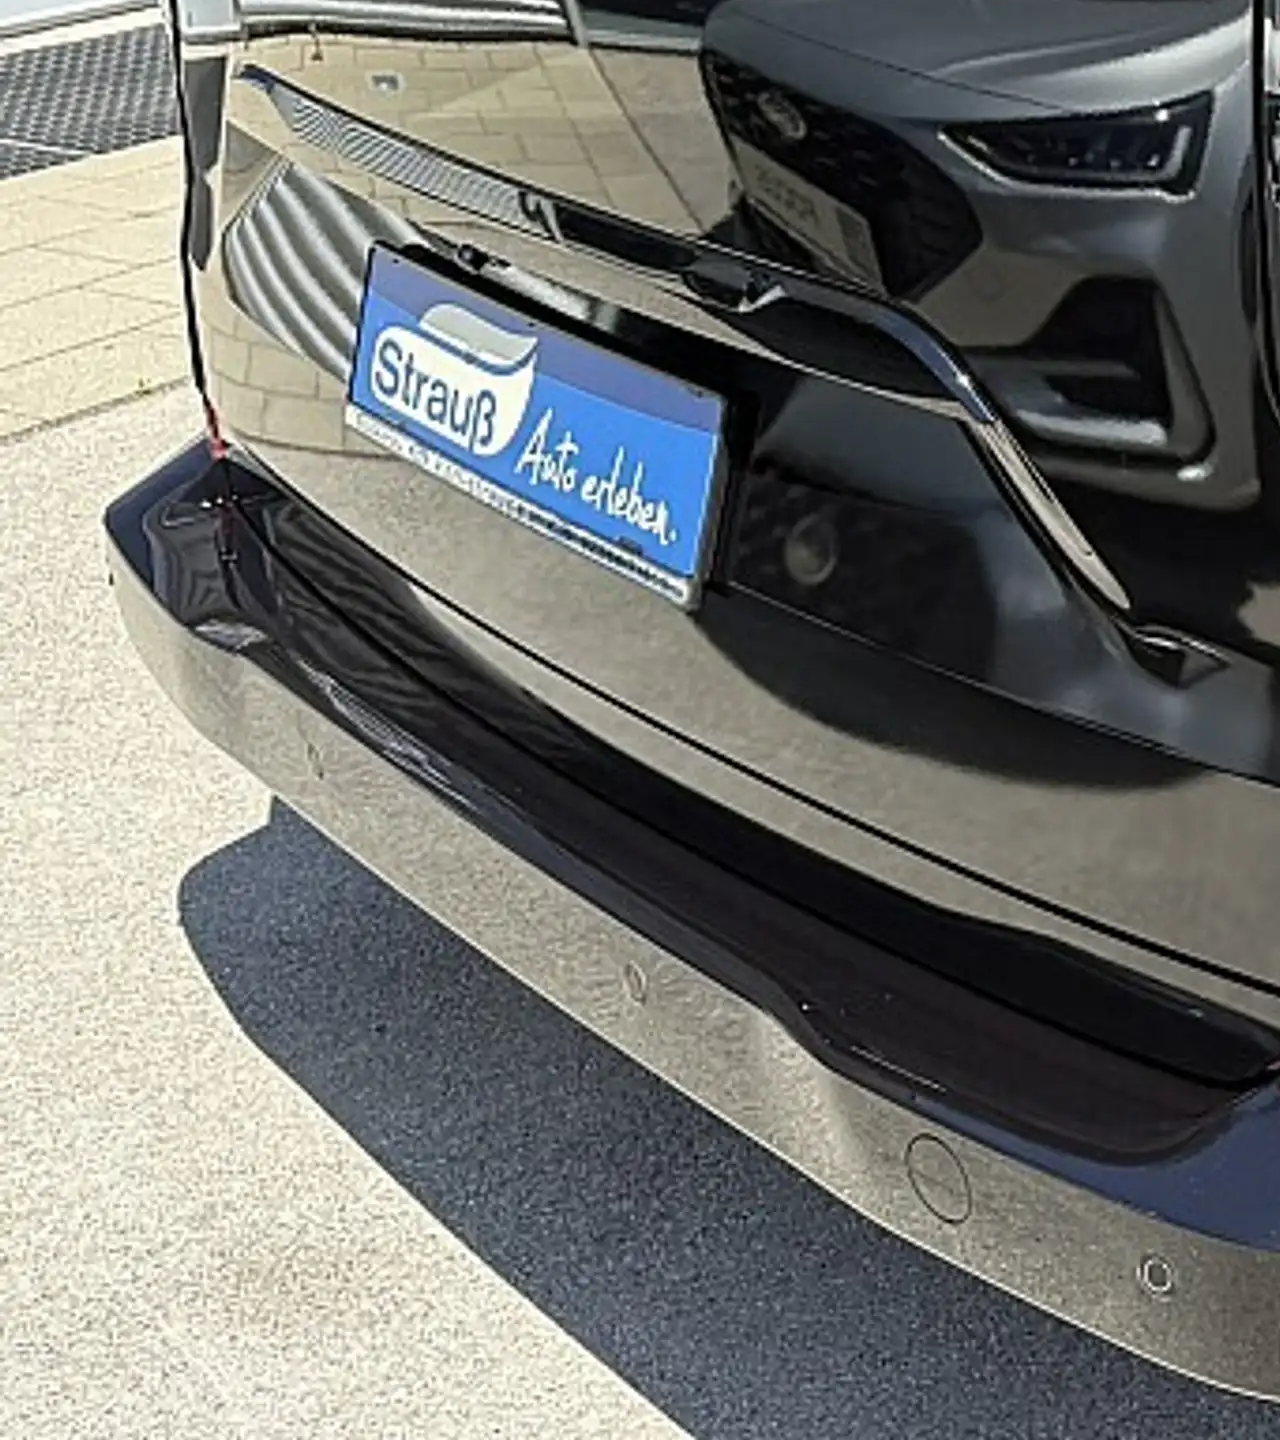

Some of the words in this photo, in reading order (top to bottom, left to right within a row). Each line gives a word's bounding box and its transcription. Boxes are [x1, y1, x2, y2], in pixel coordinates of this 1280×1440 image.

[373, 339, 497, 452] Strauß
[513, 406, 579, 492] Auto
[581, 445, 677, 546] erleben.
